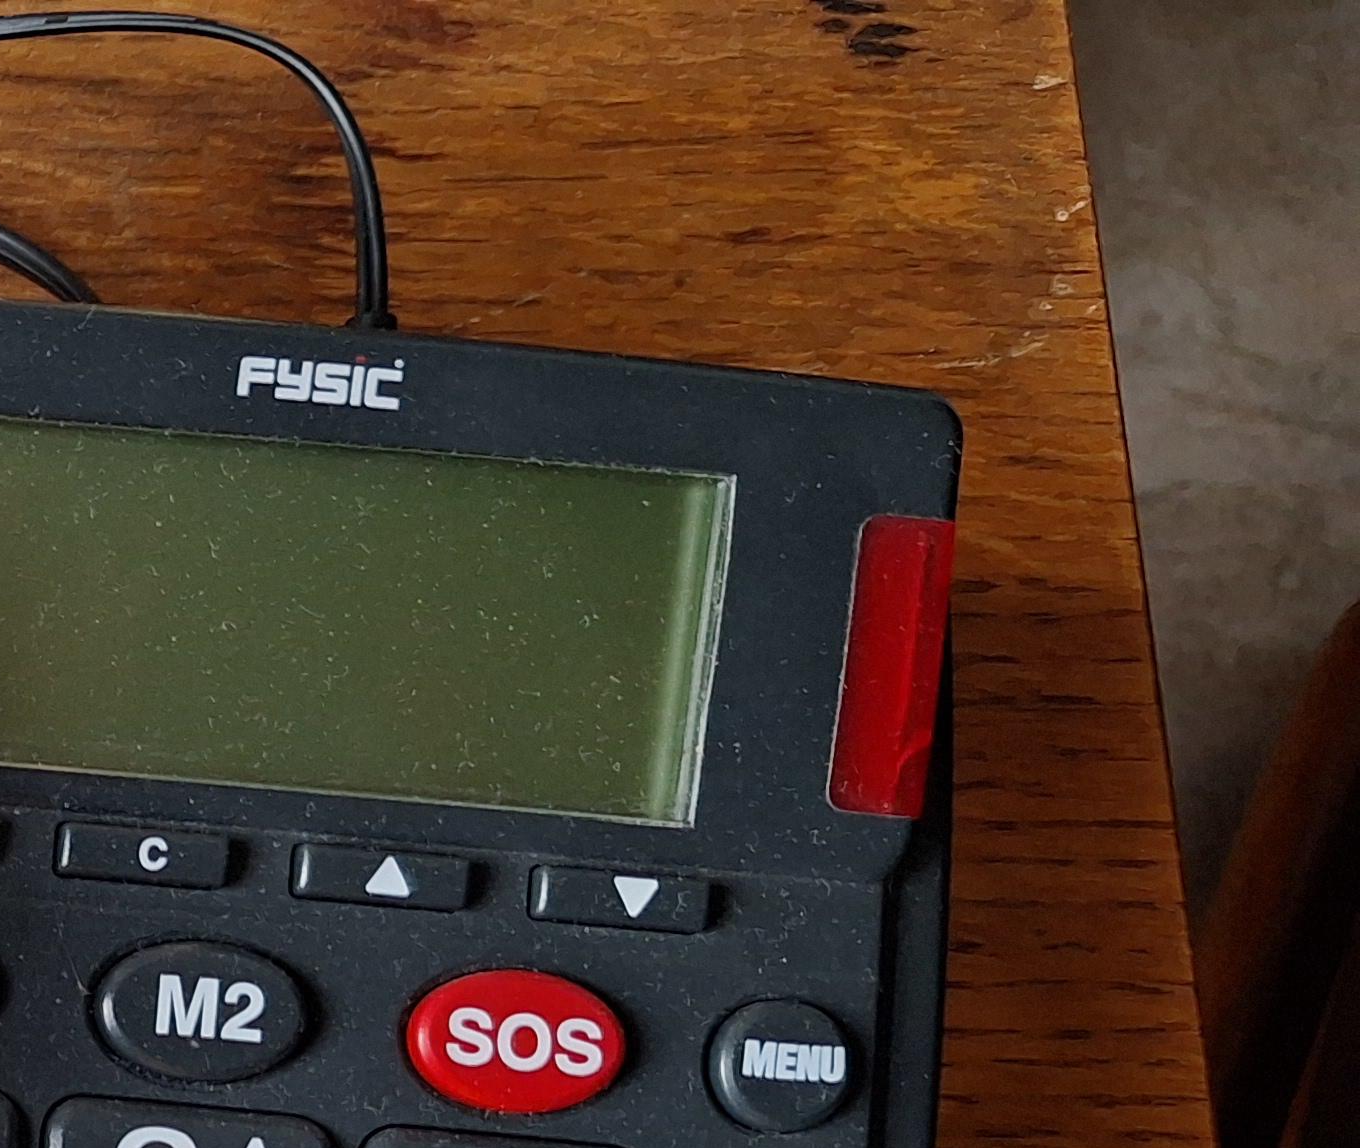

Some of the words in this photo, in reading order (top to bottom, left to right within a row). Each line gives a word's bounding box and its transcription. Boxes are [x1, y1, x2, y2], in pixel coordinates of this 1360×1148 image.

[137, 836, 170, 873] C
[155, 974, 267, 1043] M2
[445, 1007, 604, 1076] SOS
[741, 1038, 846, 1084] MENU
